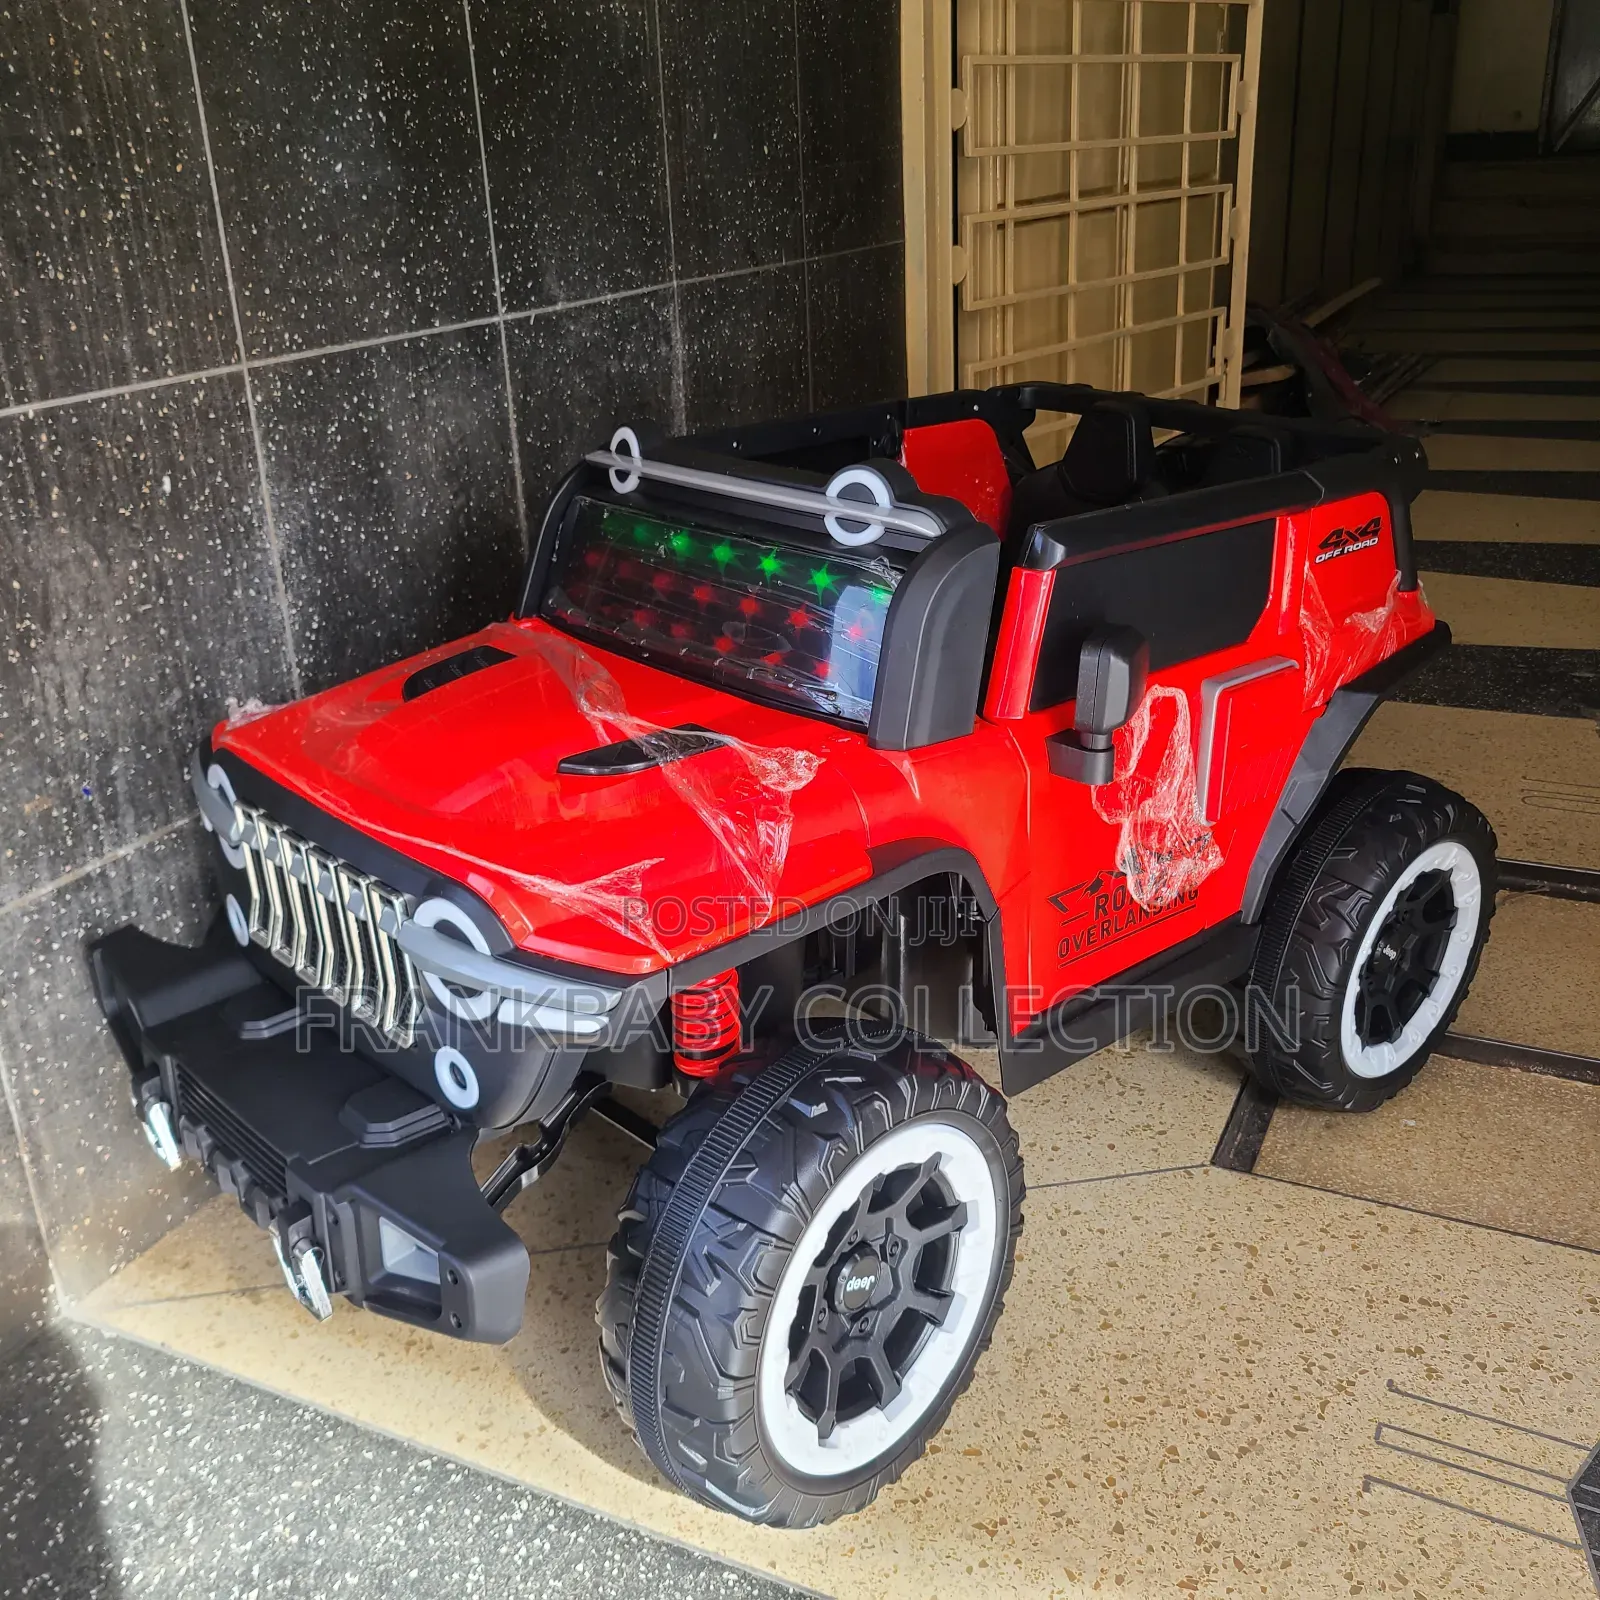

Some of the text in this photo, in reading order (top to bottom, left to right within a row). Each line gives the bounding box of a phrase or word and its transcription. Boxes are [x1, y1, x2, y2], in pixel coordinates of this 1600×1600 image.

[1315, 537, 1379, 564] OFF ROAD
[846, 1275, 875, 1292] Jeep
